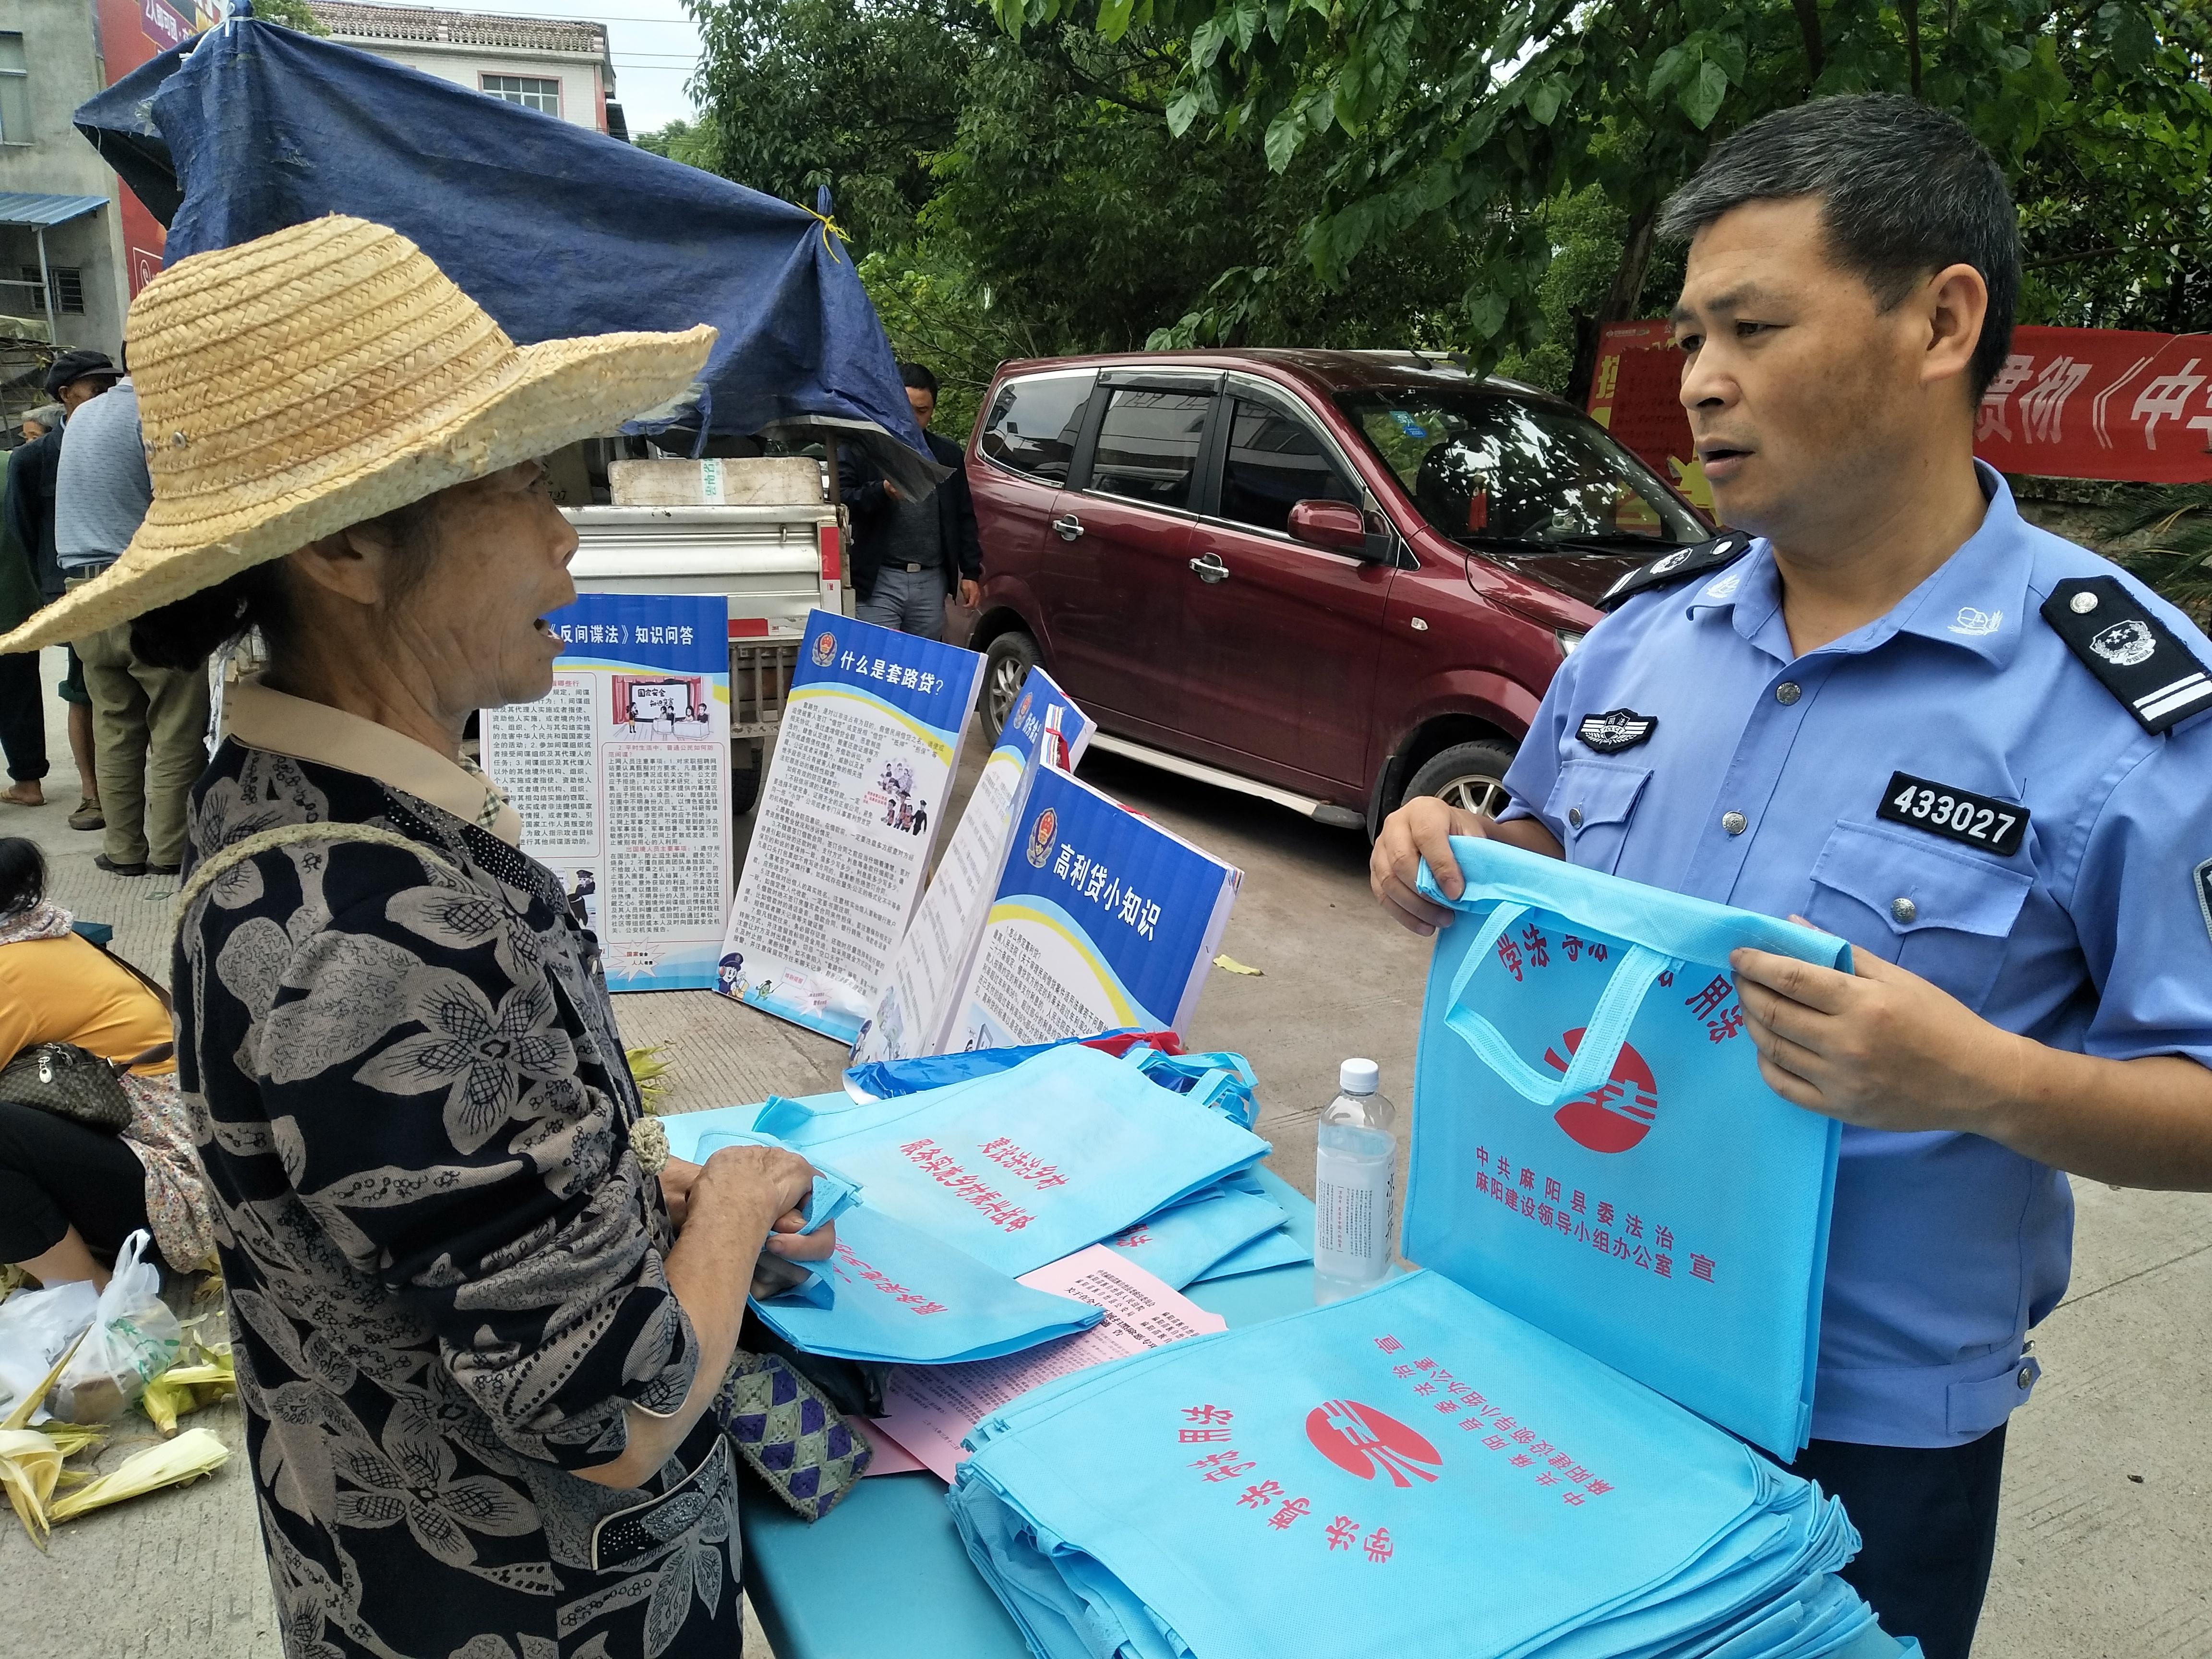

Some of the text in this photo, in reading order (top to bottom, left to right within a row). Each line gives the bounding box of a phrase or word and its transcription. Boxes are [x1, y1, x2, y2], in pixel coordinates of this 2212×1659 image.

[549, 623, 694, 645] 《反间谍法》知识问答
[2126, 650, 2152, 663] 中国司法
[1608, 717, 1626, 726] 司法
[1892, 783, 2017, 845] 433027
[1052, 842, 1161, 942] 高利贷小知识
[1497, 922, 1550, 982] 学法
[1475, 1169, 1717, 1285] 麻阳建设领导小组办公室 宣
[1476, 1145, 1675, 1250] 中共麻阳县委法治
[1151, 1316, 1189, 1339] 麻阳苗族自治
[1373, 1334, 1615, 1496] 麻阳建设领导小组办公室 宣
[1392, 1364, 1585, 1506] 中共麻阳县委法治
[1178, 1403, 1394, 1564] 学法 尊法 守法 用法
